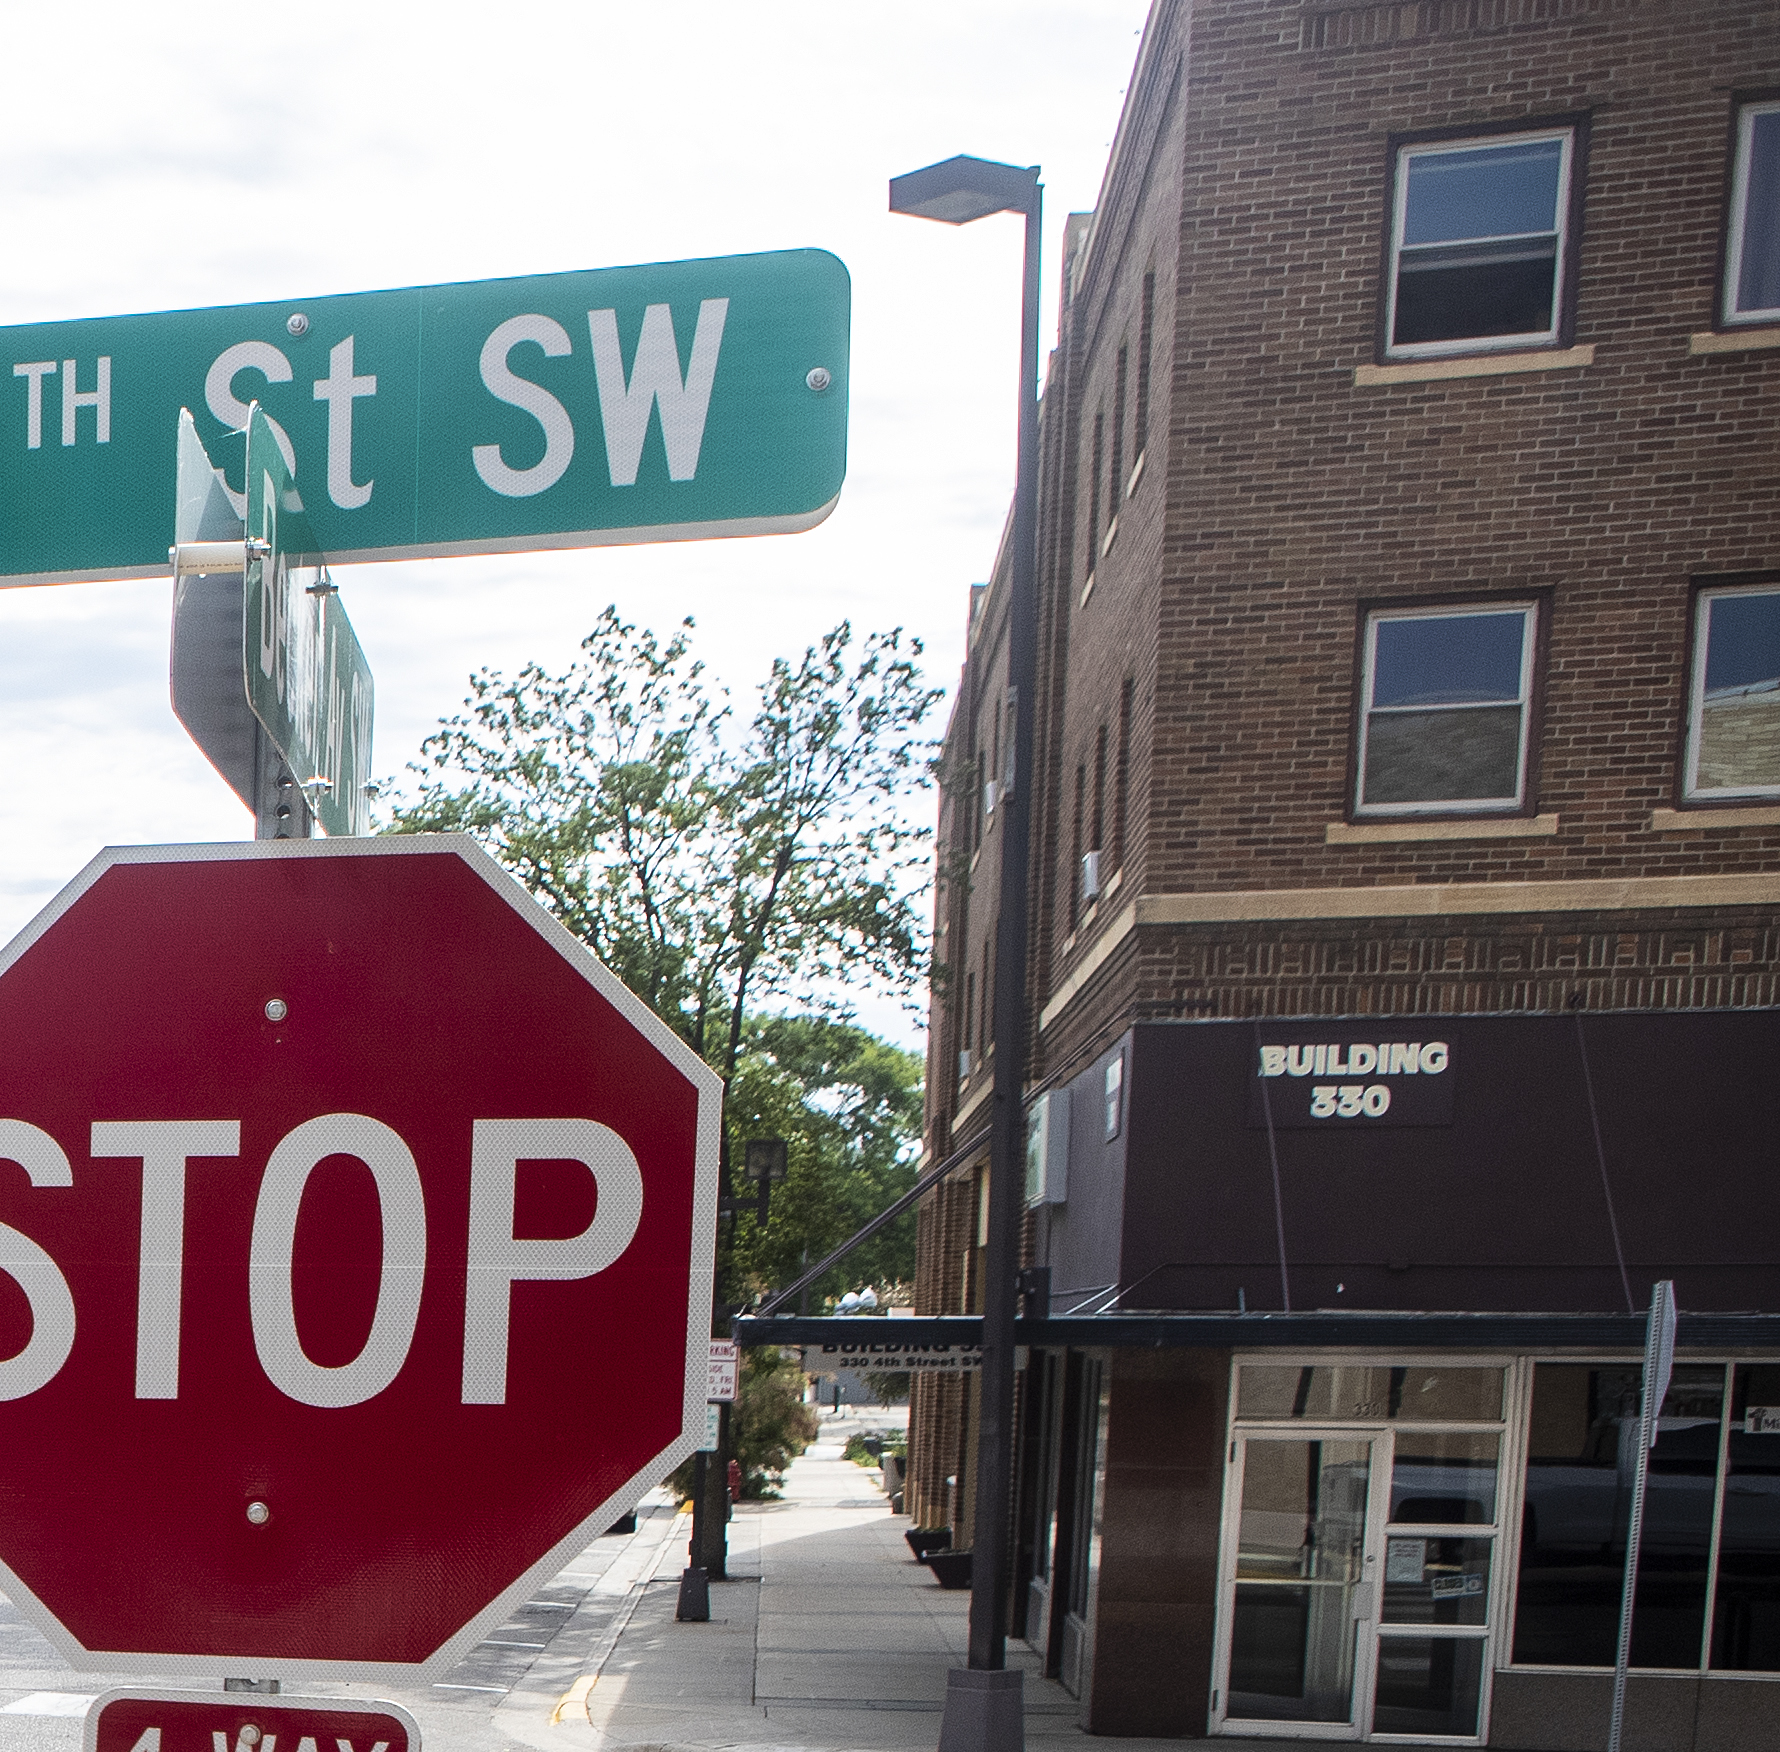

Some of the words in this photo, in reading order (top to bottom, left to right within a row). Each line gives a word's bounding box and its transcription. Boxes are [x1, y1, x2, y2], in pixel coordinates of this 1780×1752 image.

[204, 336, 377, 519] St
[473, 297, 729, 498] SW
[1259, 1042, 1449, 1076] BUILDING
[1311, 1085, 1391, 1118] 330
[840, 1357, 869, 1367] 330
[873, 1357, 900, 1367] 4th
[906, 1357, 955, 1366] Street
